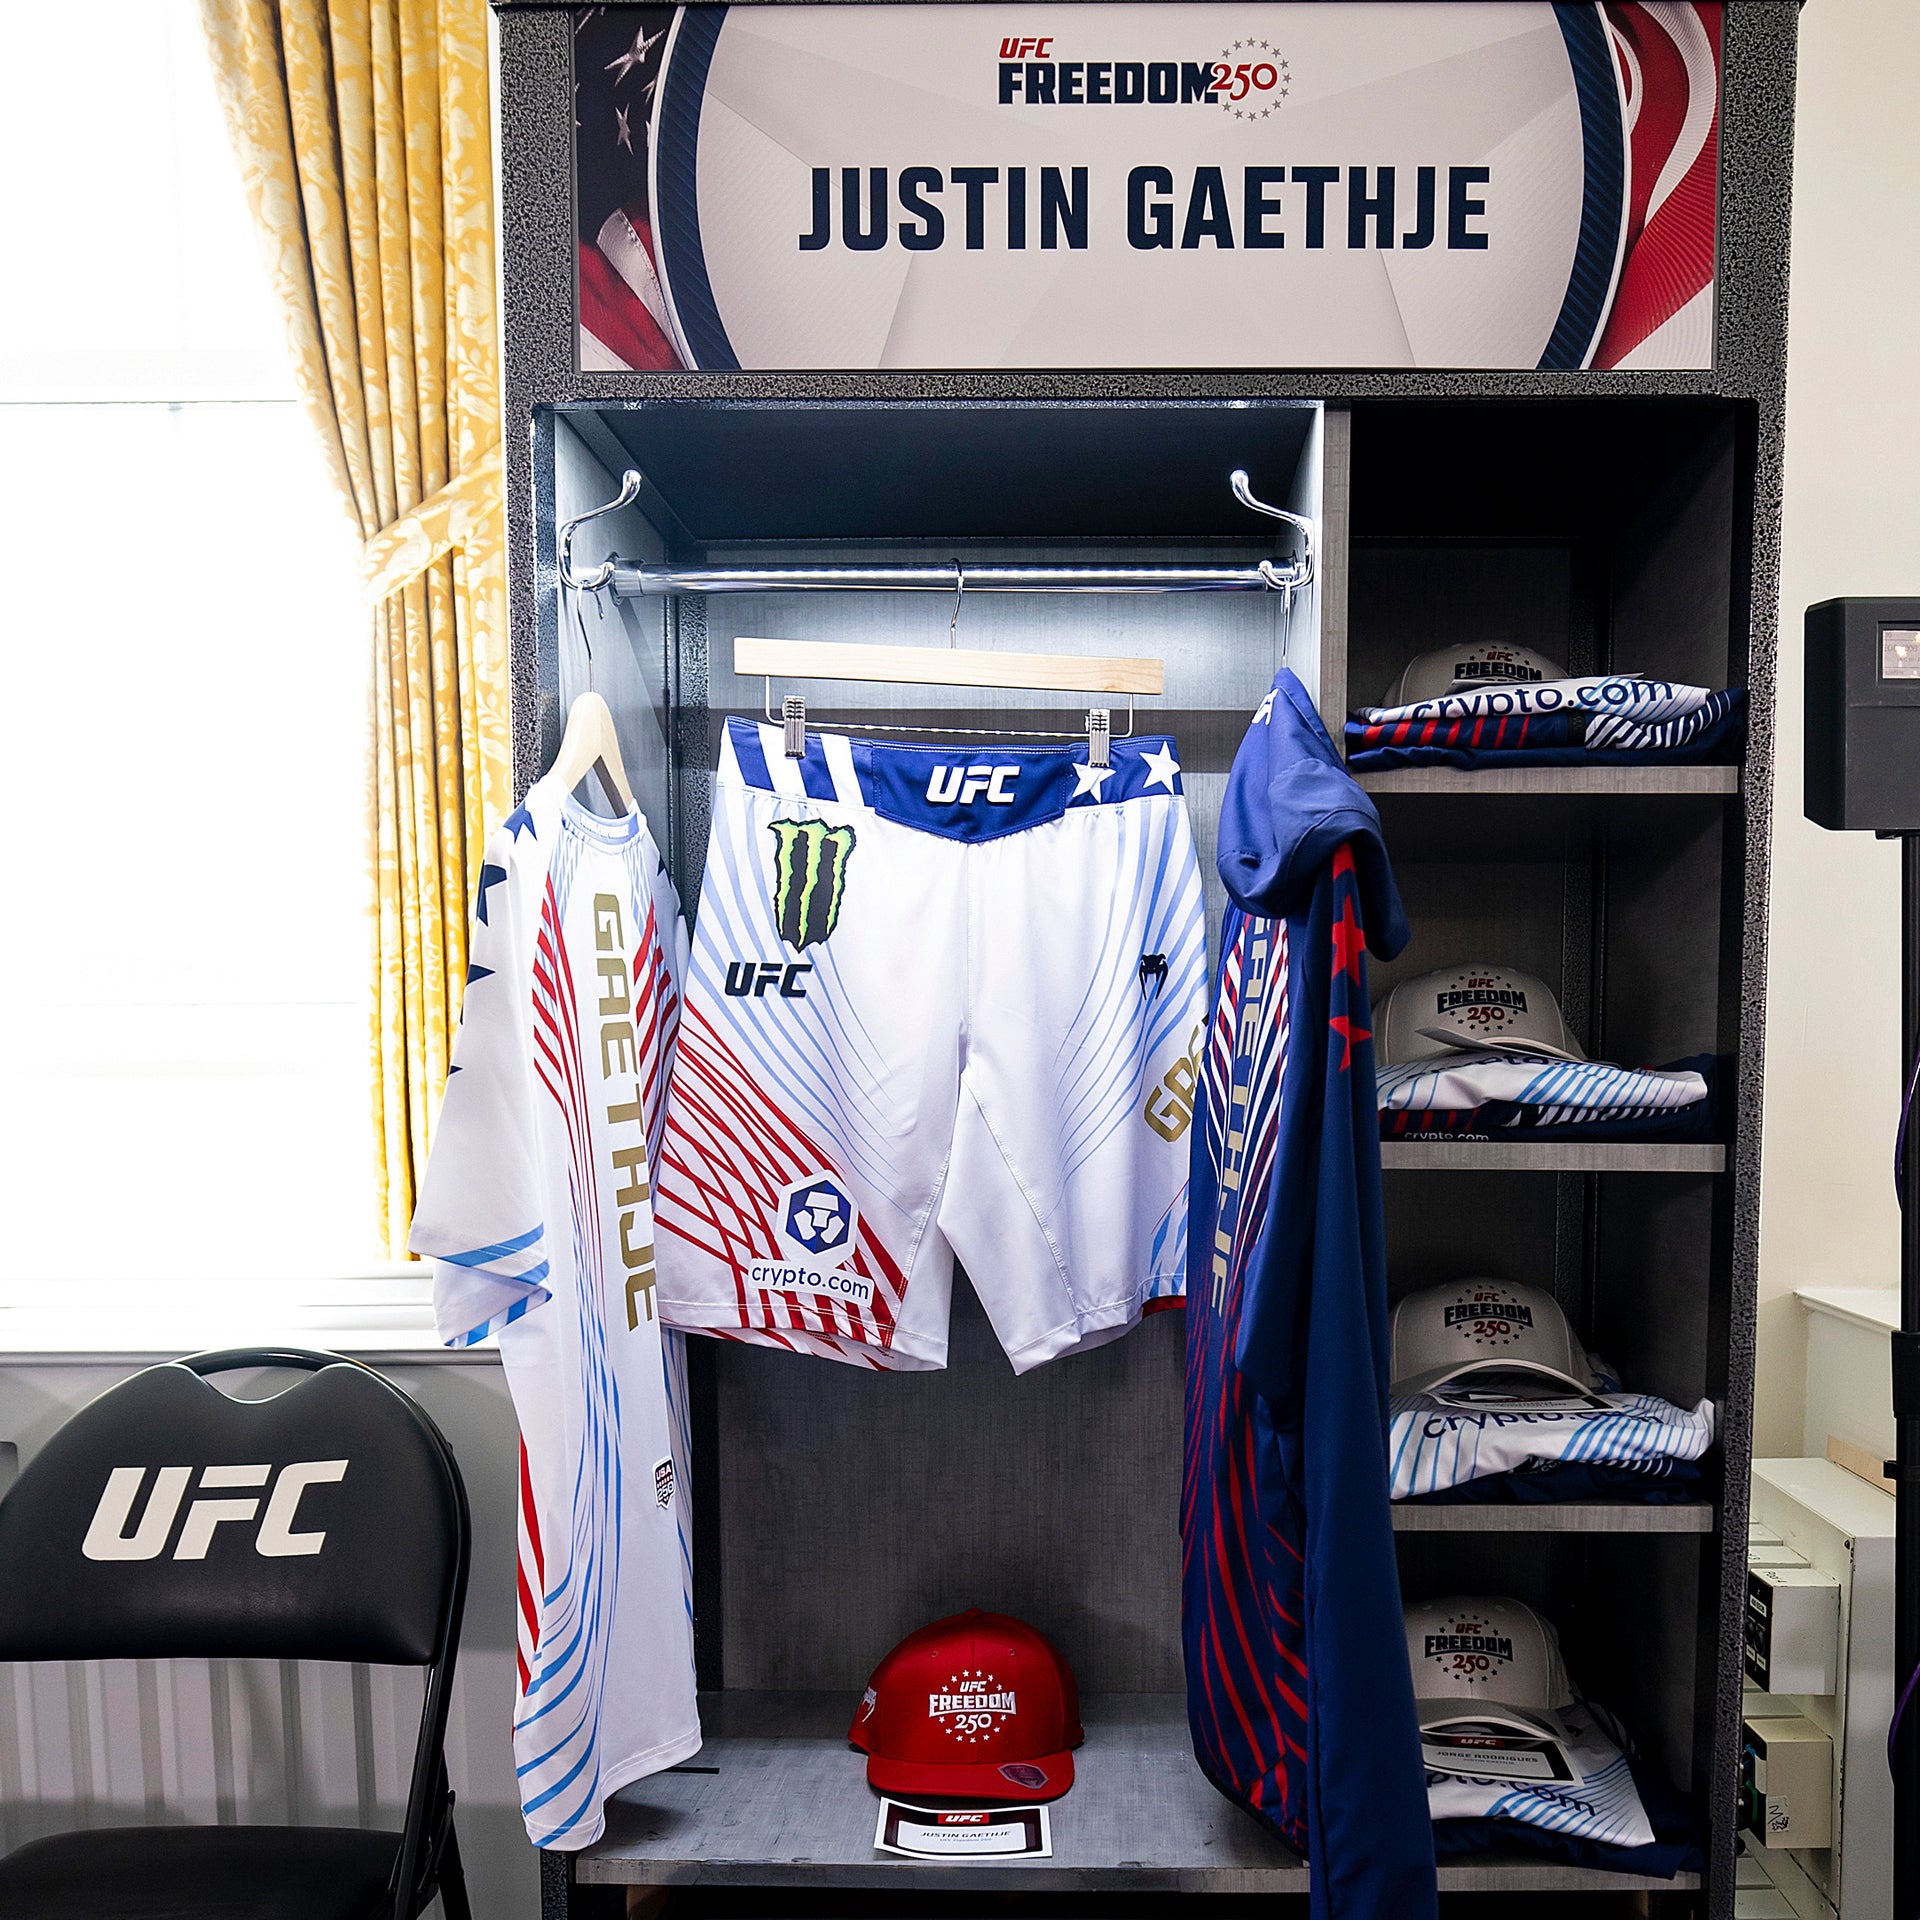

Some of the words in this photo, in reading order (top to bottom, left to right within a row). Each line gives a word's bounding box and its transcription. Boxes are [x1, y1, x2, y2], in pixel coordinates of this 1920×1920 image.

[999, 37, 1054, 59] UFC
[998, 62, 1219, 104] FREEDOM
[1210, 63, 1279, 100] 250
[799, 166, 1090, 251] JUSTIN
[1127, 165, 1491, 250] GAETHJE
[1486, 651, 1514, 662] UFC
[1454, 662, 1543, 681] FREEDOM
[926, 765, 1022, 804] UFC
[724, 962, 814, 999] UFC
[1468, 978, 1494, 988] UFC
[1437, 989, 1528, 1014] FREEDOM
[1467, 1006, 1505, 1024] 250
[594, 891, 657, 1333] GAETHJE
[752, 1267, 869, 1300] crypto.com
[1473, 1292, 1500, 1303] UFC
[1444, 1303, 1534, 1328] FREEDOM
[1473, 1320, 1511, 1337] 250
[656, 1464, 672, 1480] USA
[657, 1481, 674, 1501] 250
[81, 1459, 349, 1561] UFC
[1455, 1623, 1482, 1635] UFC
[1424, 1634, 1514, 1662] FREEDOM
[1452, 1654, 1490, 1674] 250
[959, 1680, 988, 1693] UFC
[928, 1691, 1017, 1718] FREEDOM
[954, 1713, 993, 1734] 250
[1460, 1738, 1497, 1746] UFC
[945, 1814, 983, 1822] UFC
